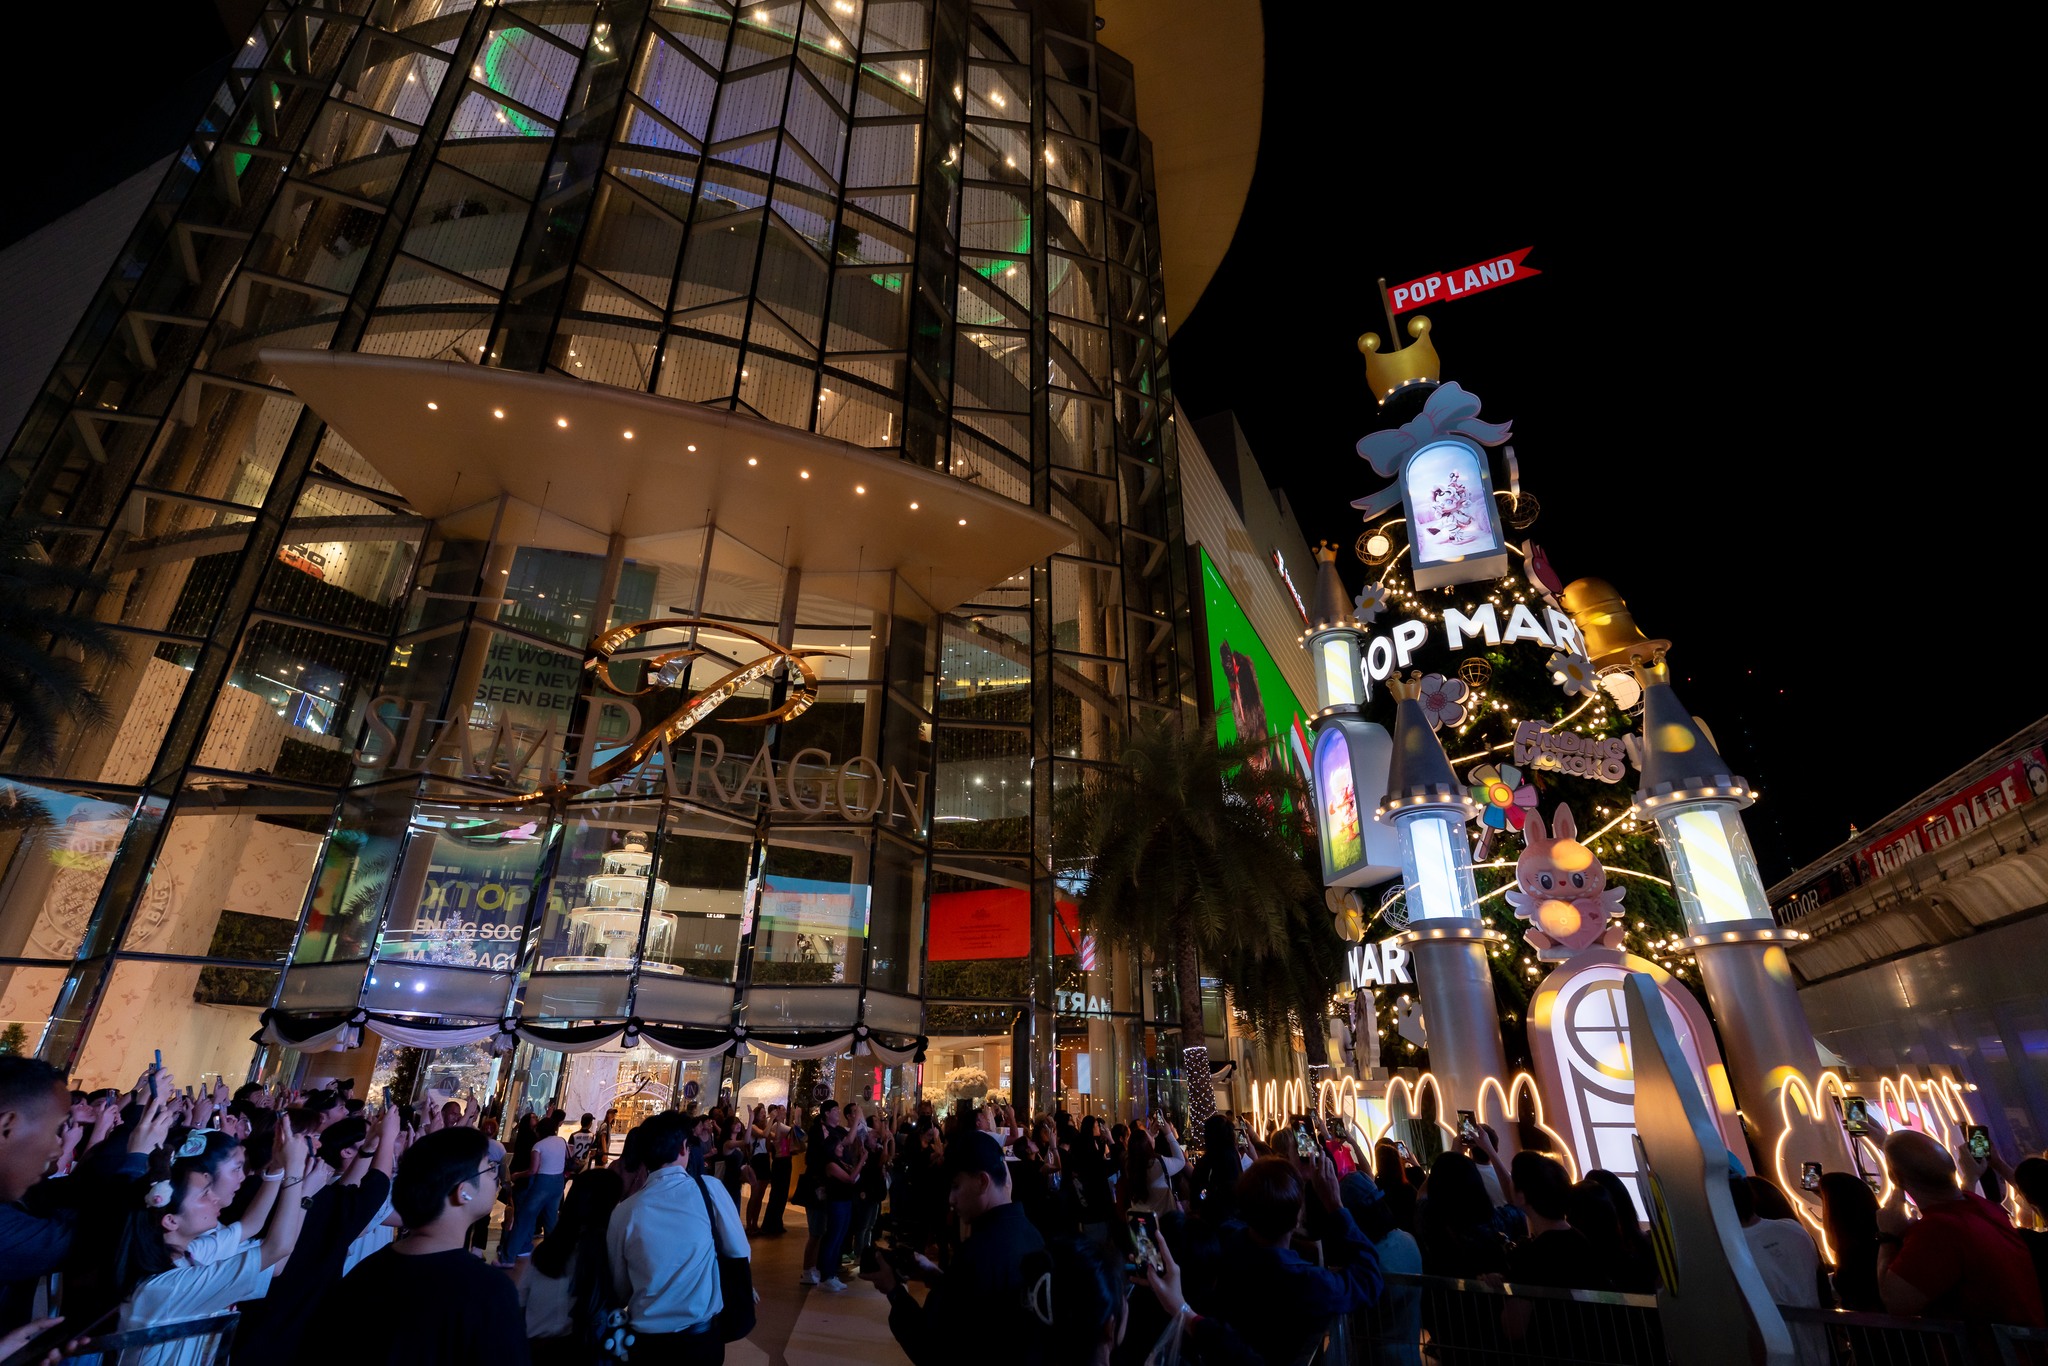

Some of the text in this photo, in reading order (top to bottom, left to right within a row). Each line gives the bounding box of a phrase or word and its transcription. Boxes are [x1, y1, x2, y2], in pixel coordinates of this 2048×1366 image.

[1393, 258, 1515, 309] POP LAND
[535, 671, 580, 690] NEV
[1360, 619, 1428, 702] POP
[476, 684, 533, 706] SEEN
[1516, 720, 1626, 762] FINDING
[352, 695, 930, 829] SIAM PARAGON
[1515, 744, 1626, 783] MOKOKO
[1872, 776, 2021, 878] BORN TO DARE
[58, 896, 84, 914] PARIS
[147, 880, 170, 922] BAGS
[1777, 888, 1820, 926] TUDOR
[687, 1084, 696, 1095] IN
